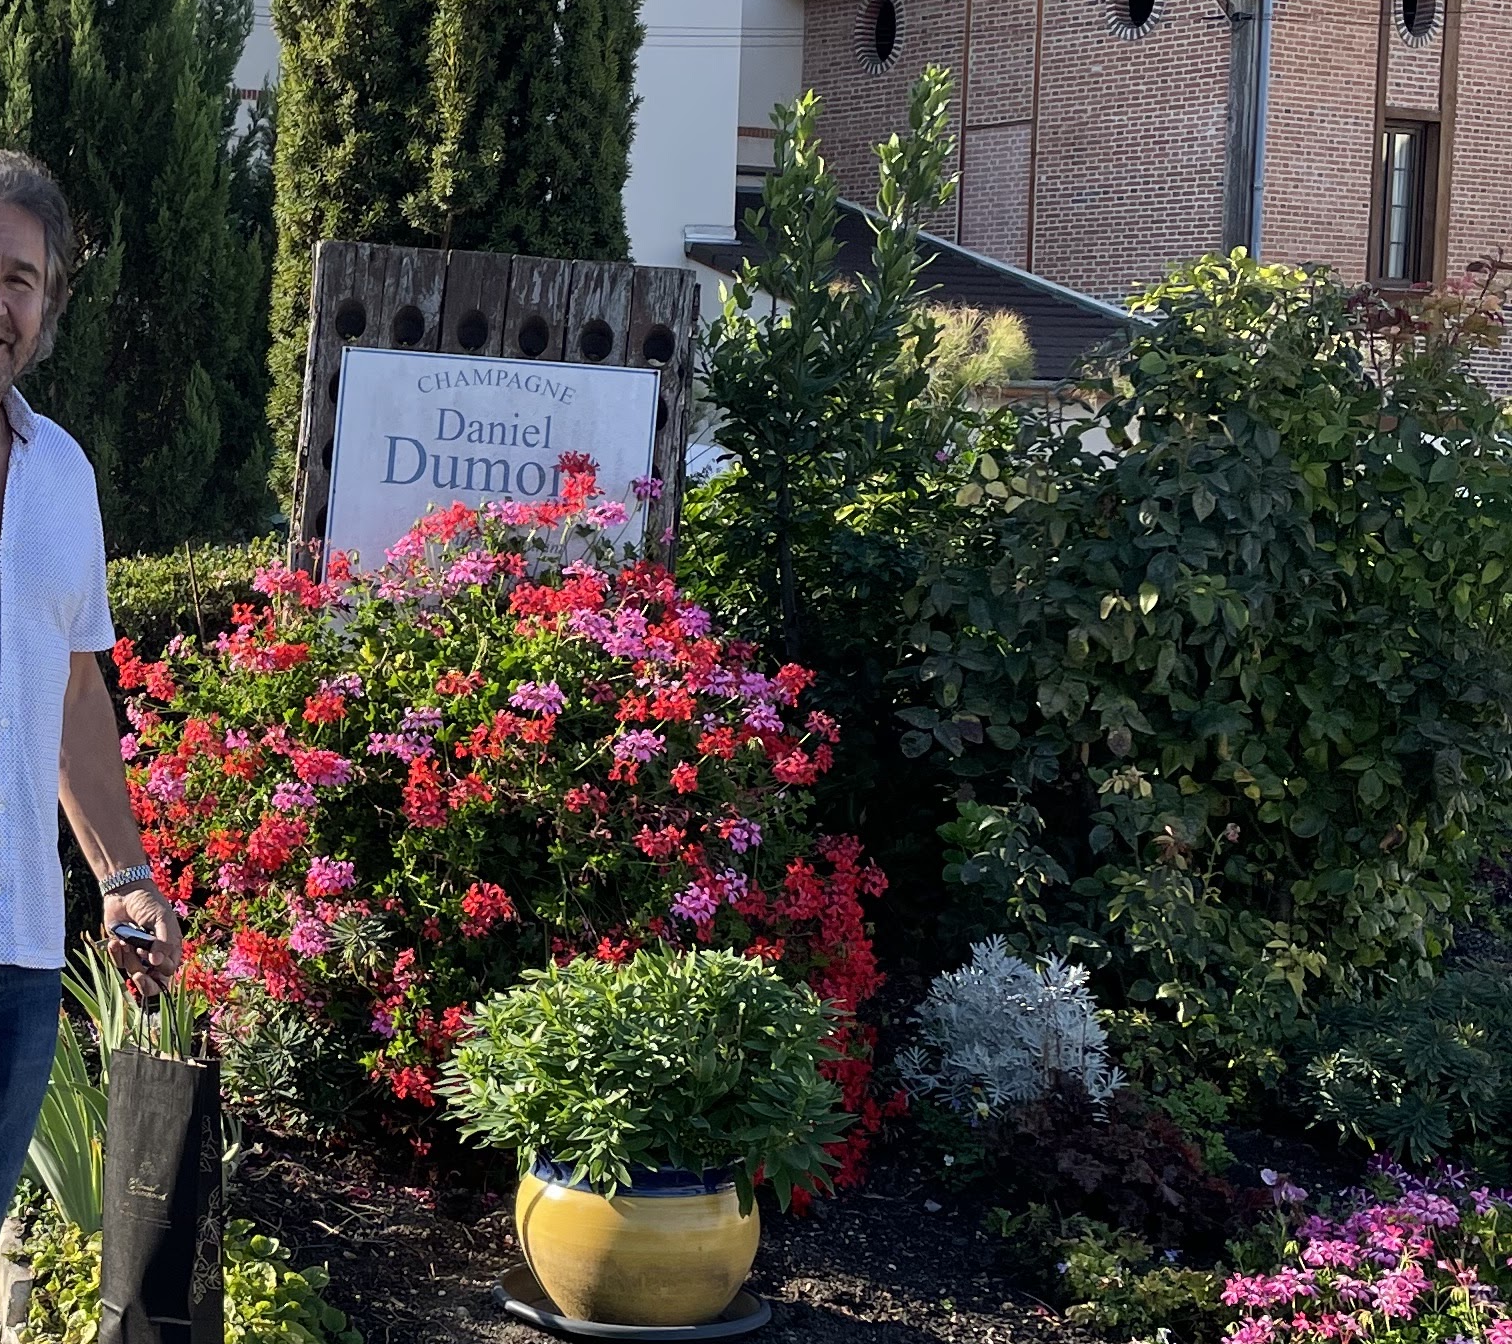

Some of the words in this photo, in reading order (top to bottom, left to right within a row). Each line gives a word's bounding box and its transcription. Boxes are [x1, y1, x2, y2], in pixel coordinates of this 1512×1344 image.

[417, 368, 577, 405] CHAMPAGNE
[435, 407, 551, 449] Daniel
[380, 435, 601, 500] Dumo
